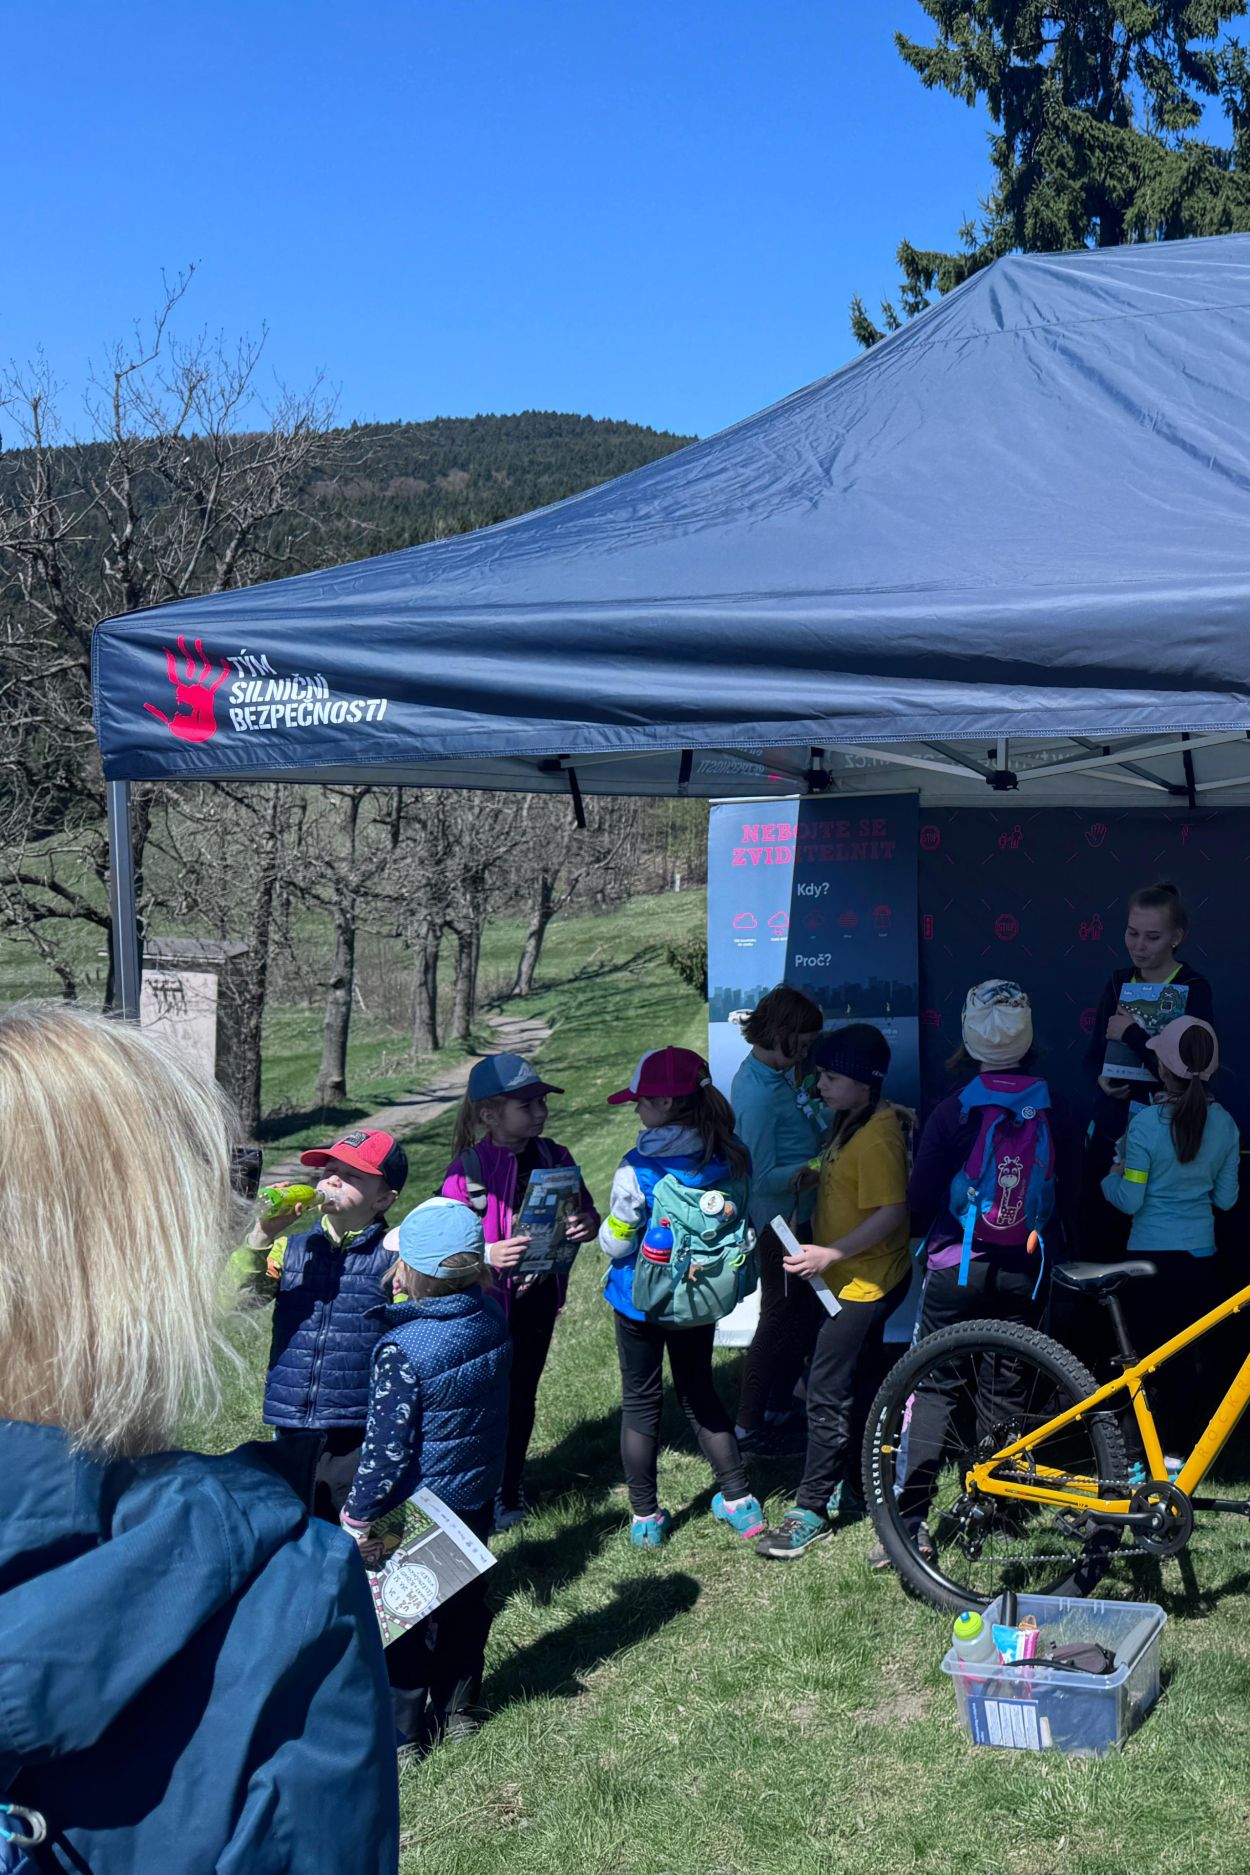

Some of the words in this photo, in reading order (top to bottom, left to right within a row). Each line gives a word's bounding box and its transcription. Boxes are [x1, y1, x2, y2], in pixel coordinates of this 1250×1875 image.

[227, 649, 277, 678] TÝM
[229, 673, 329, 705] SILNIČNÍ
[229, 698, 388, 732] BEZPEČNOSTI
[741, 820, 849, 843] NEBOJTE
[859, 818, 888, 838] SE
[797, 882, 830, 898] Kdy?
[795, 954, 832, 967] Proč?
